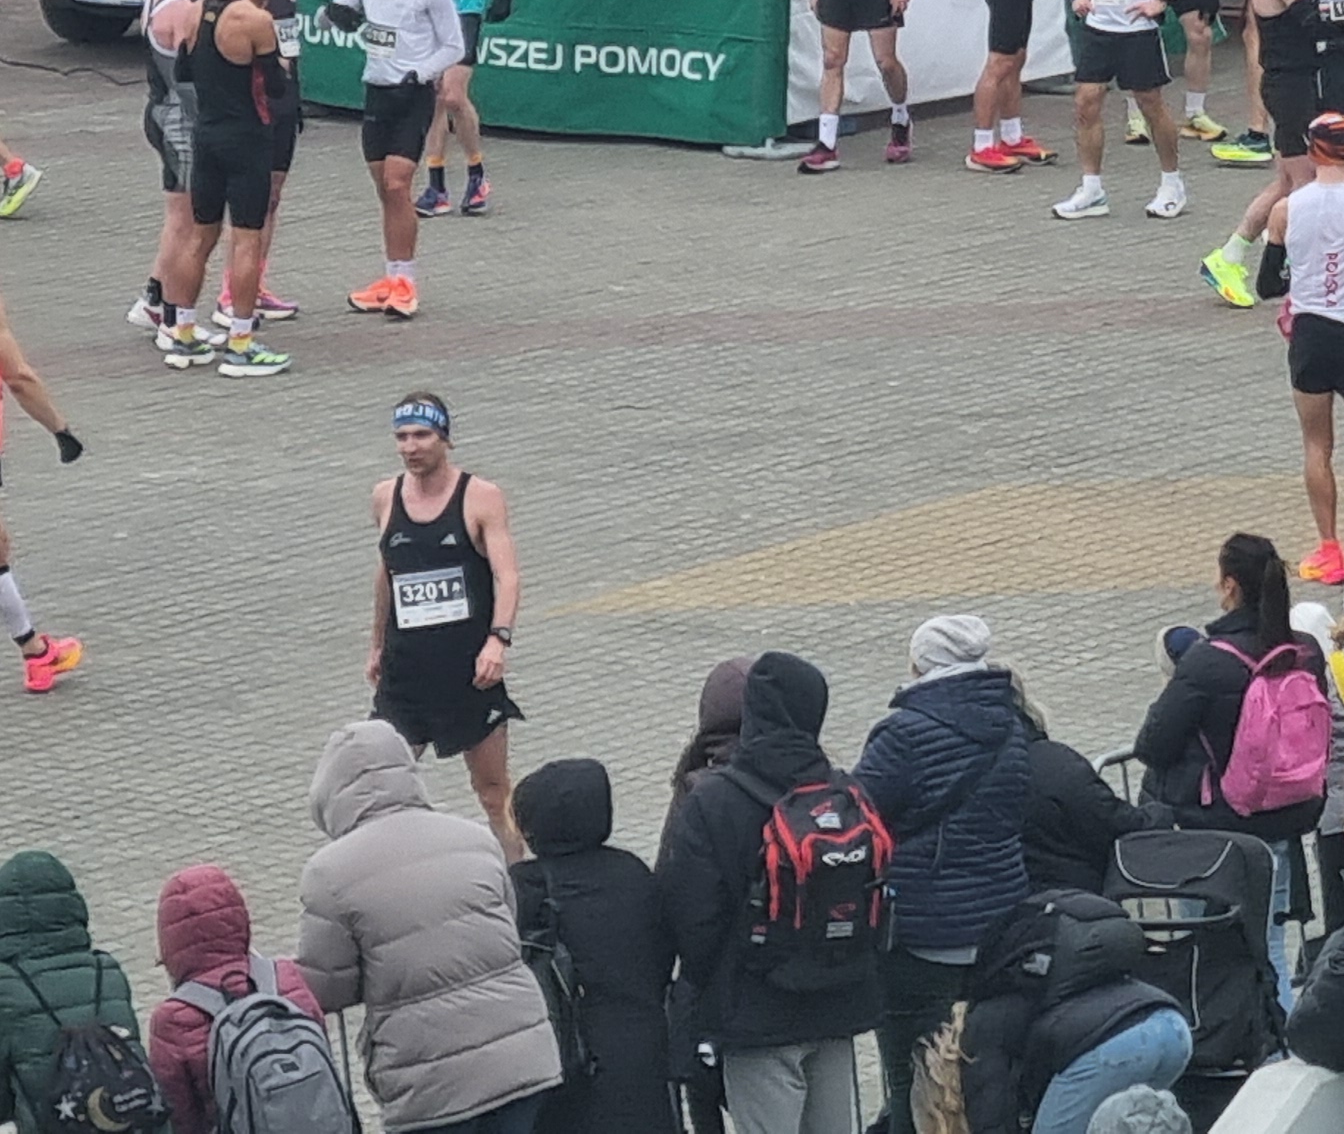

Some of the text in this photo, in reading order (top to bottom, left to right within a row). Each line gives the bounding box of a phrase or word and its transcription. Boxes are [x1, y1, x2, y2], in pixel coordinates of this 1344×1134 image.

[574, 44, 726, 82] POMOCY
[1324, 252, 1339, 309] POLSKA
[402, 579, 449, 604] 3201
